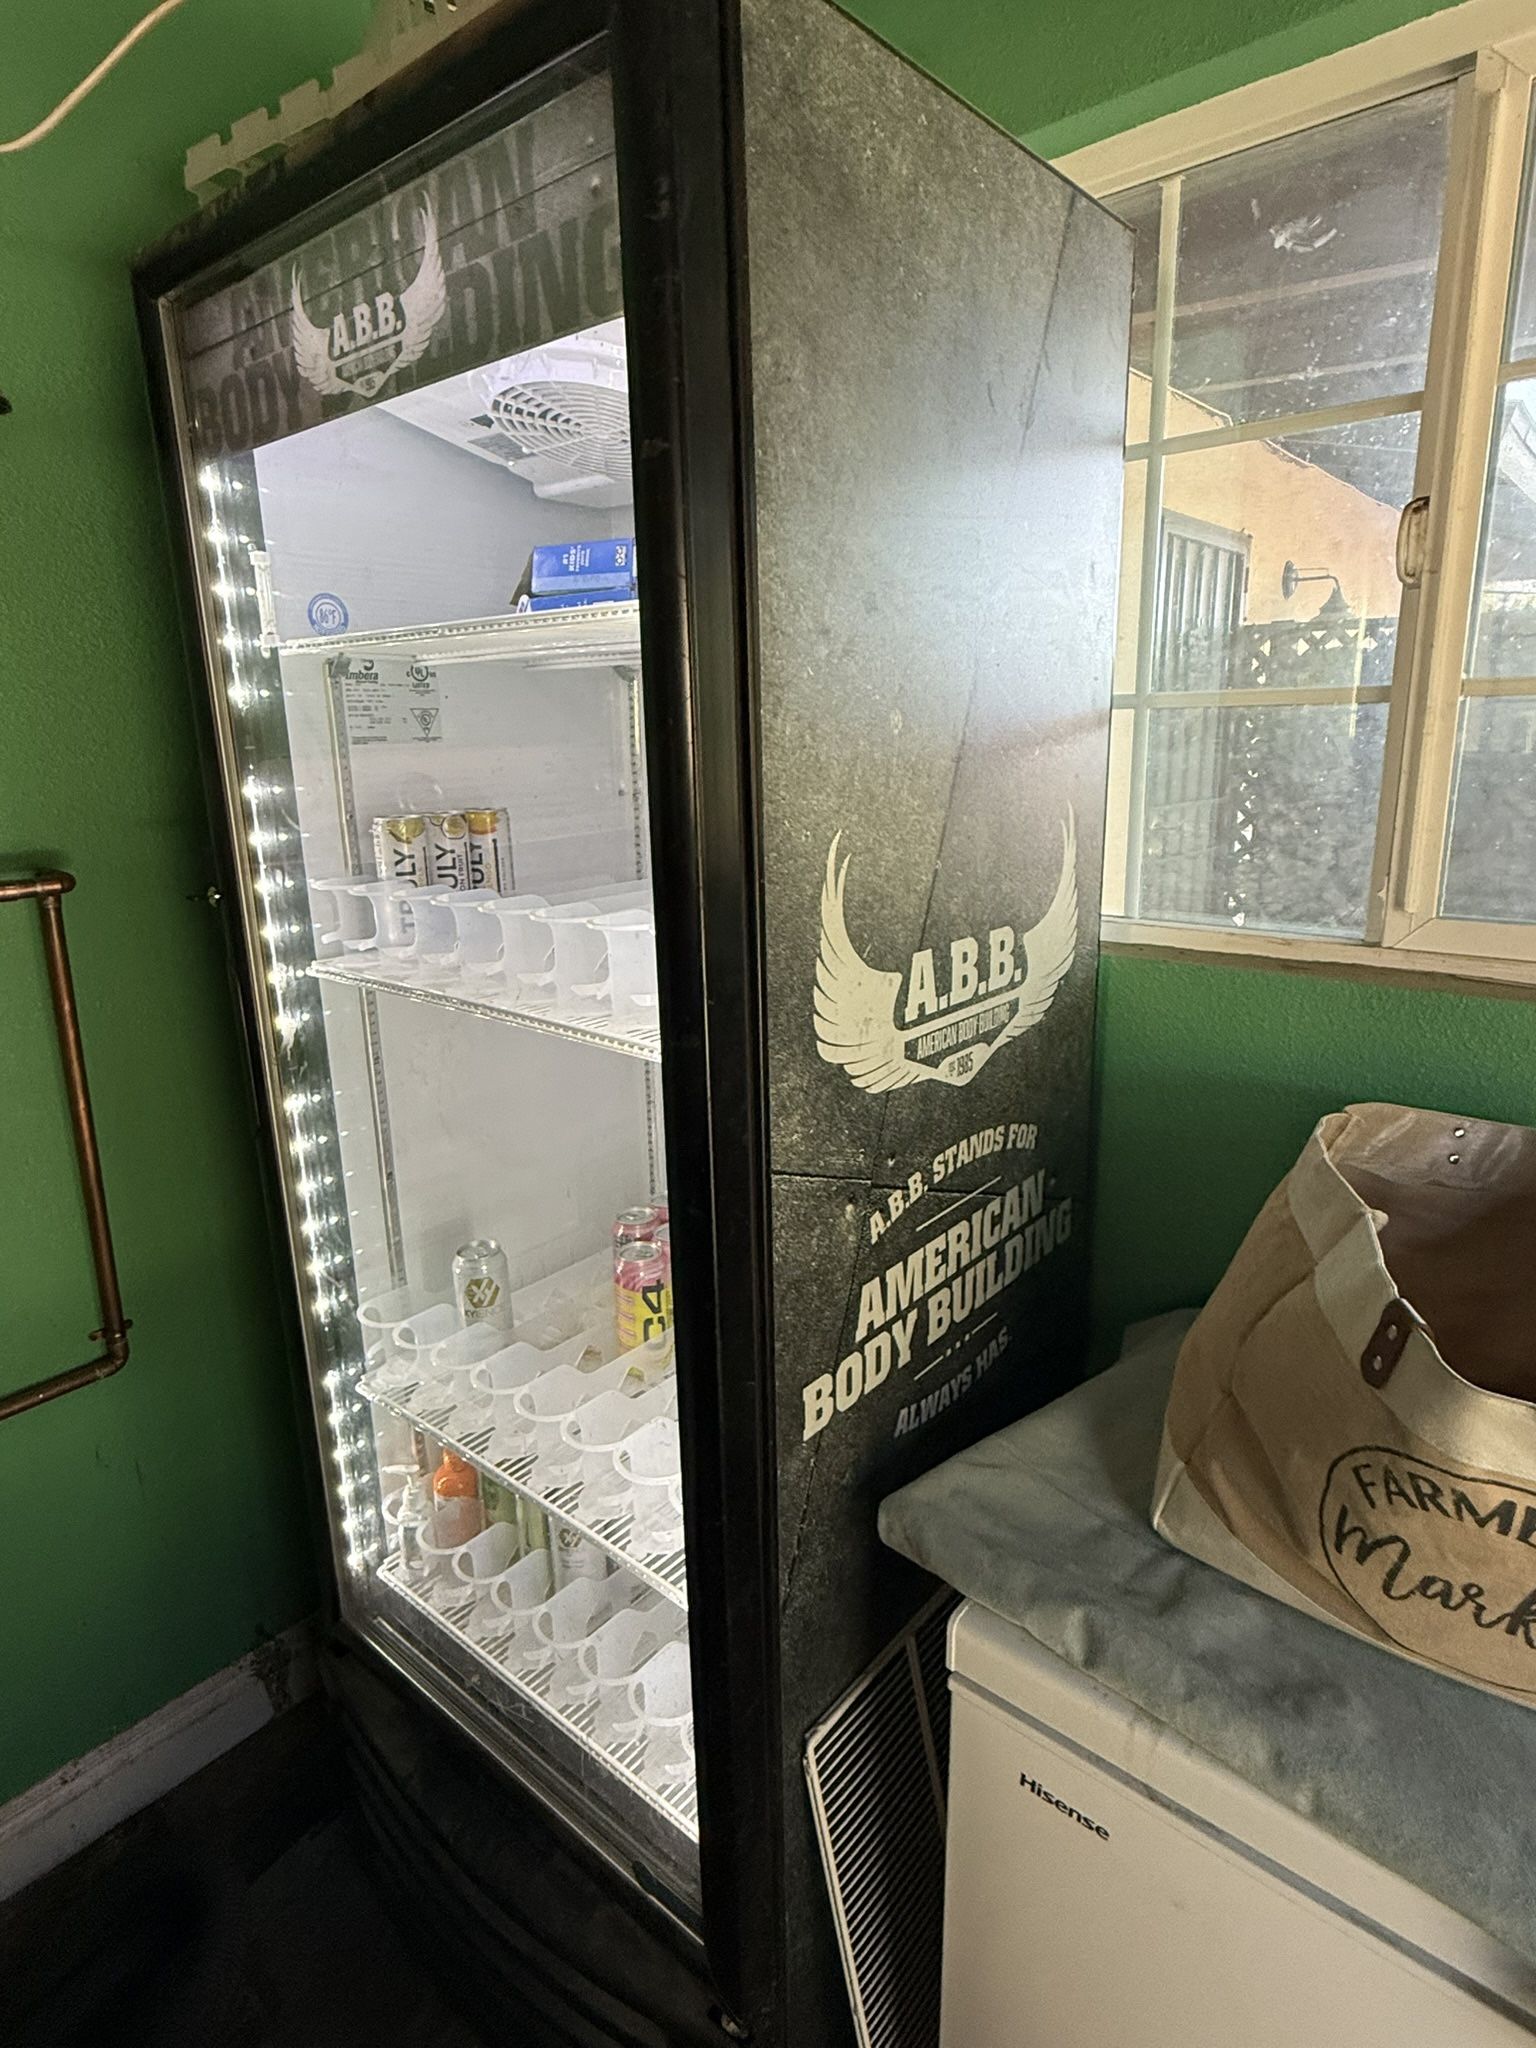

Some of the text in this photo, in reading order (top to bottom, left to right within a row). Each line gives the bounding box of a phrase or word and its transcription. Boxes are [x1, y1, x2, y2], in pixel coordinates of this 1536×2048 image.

[333, 291, 402, 357] A.B.B.
[904, 926, 1022, 1024] A.B.B.
[917, 1023, 958, 1060] AMERICAN
[958, 1016, 979, 1045] BODY
[870, 1123, 1039, 1245] A.B.B. STANDS FOR
[855, 1168, 1046, 1343] AMERICAN
[803, 1197, 1072, 1442] BODY BUILDING
[893, 1364, 973, 1439] ALWAYS
[1019, 1772, 1110, 1841] Hisense
